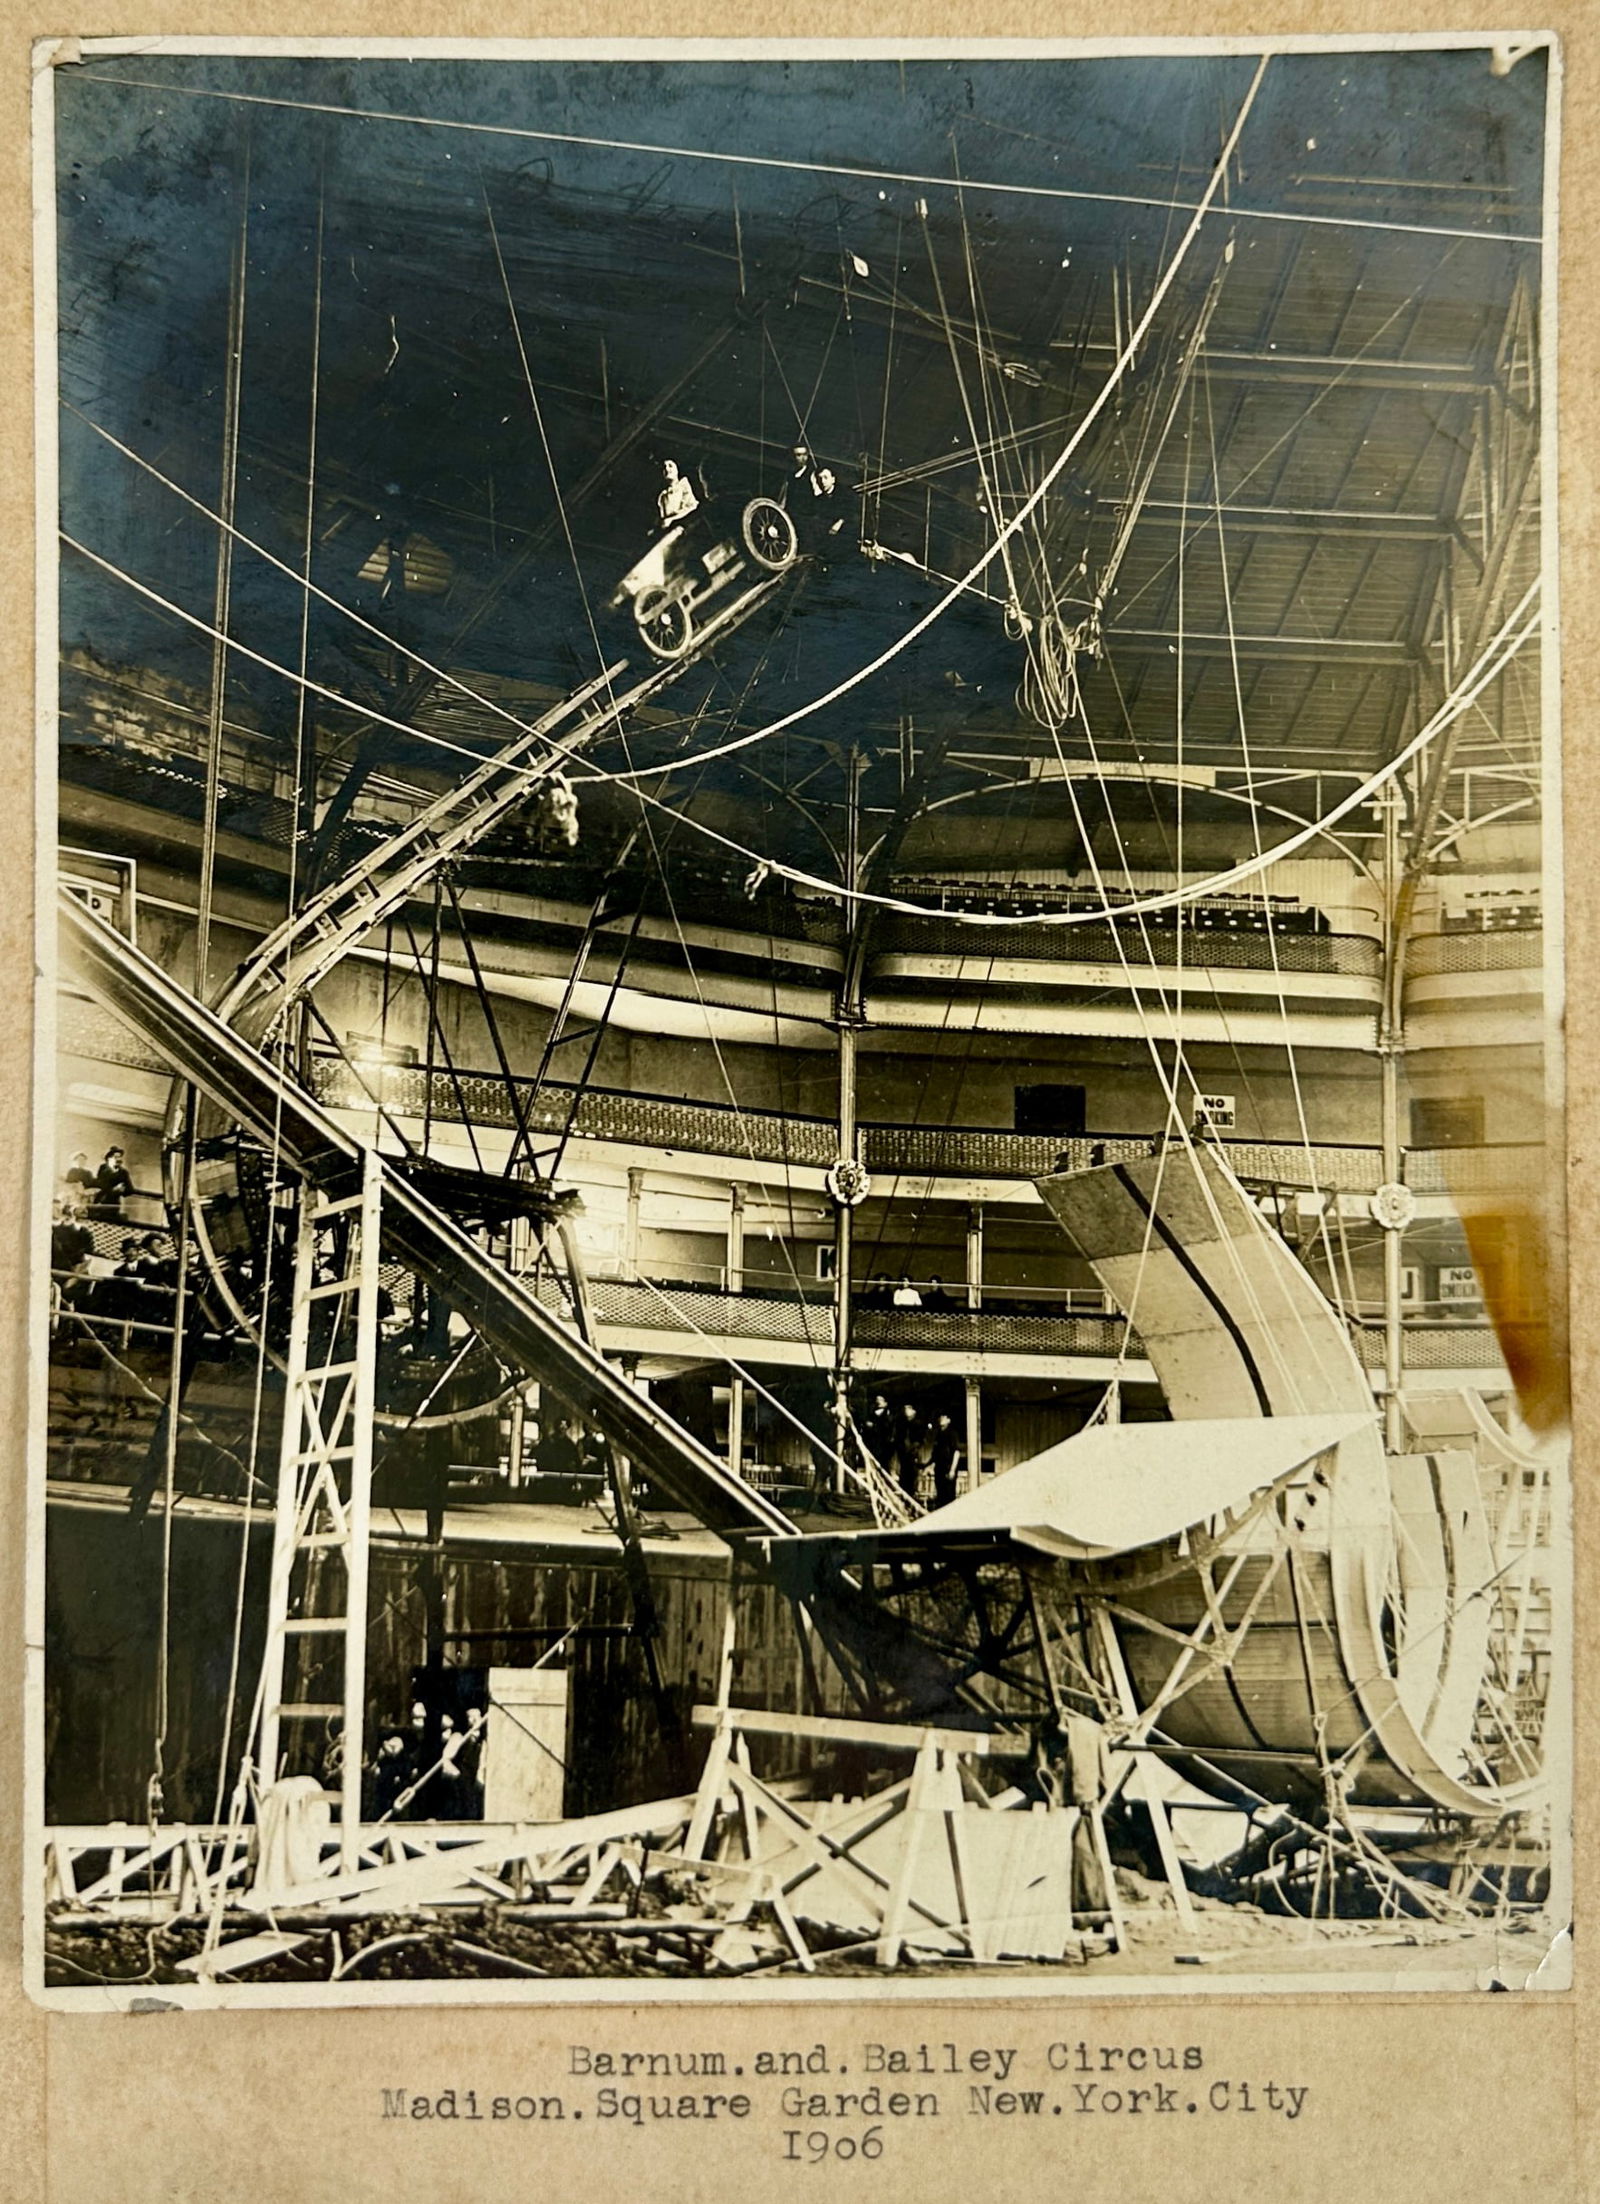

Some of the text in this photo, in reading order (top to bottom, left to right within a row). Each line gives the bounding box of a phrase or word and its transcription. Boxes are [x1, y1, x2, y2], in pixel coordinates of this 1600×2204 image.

[1203, 1097, 1225, 1108] NO
[820, 1248, 837, 1278] K
[1450, 1270, 1473, 1281] NO
[1047, 2042, 1204, 2073] Circus
[781, 2085, 941, 2118] Garden
